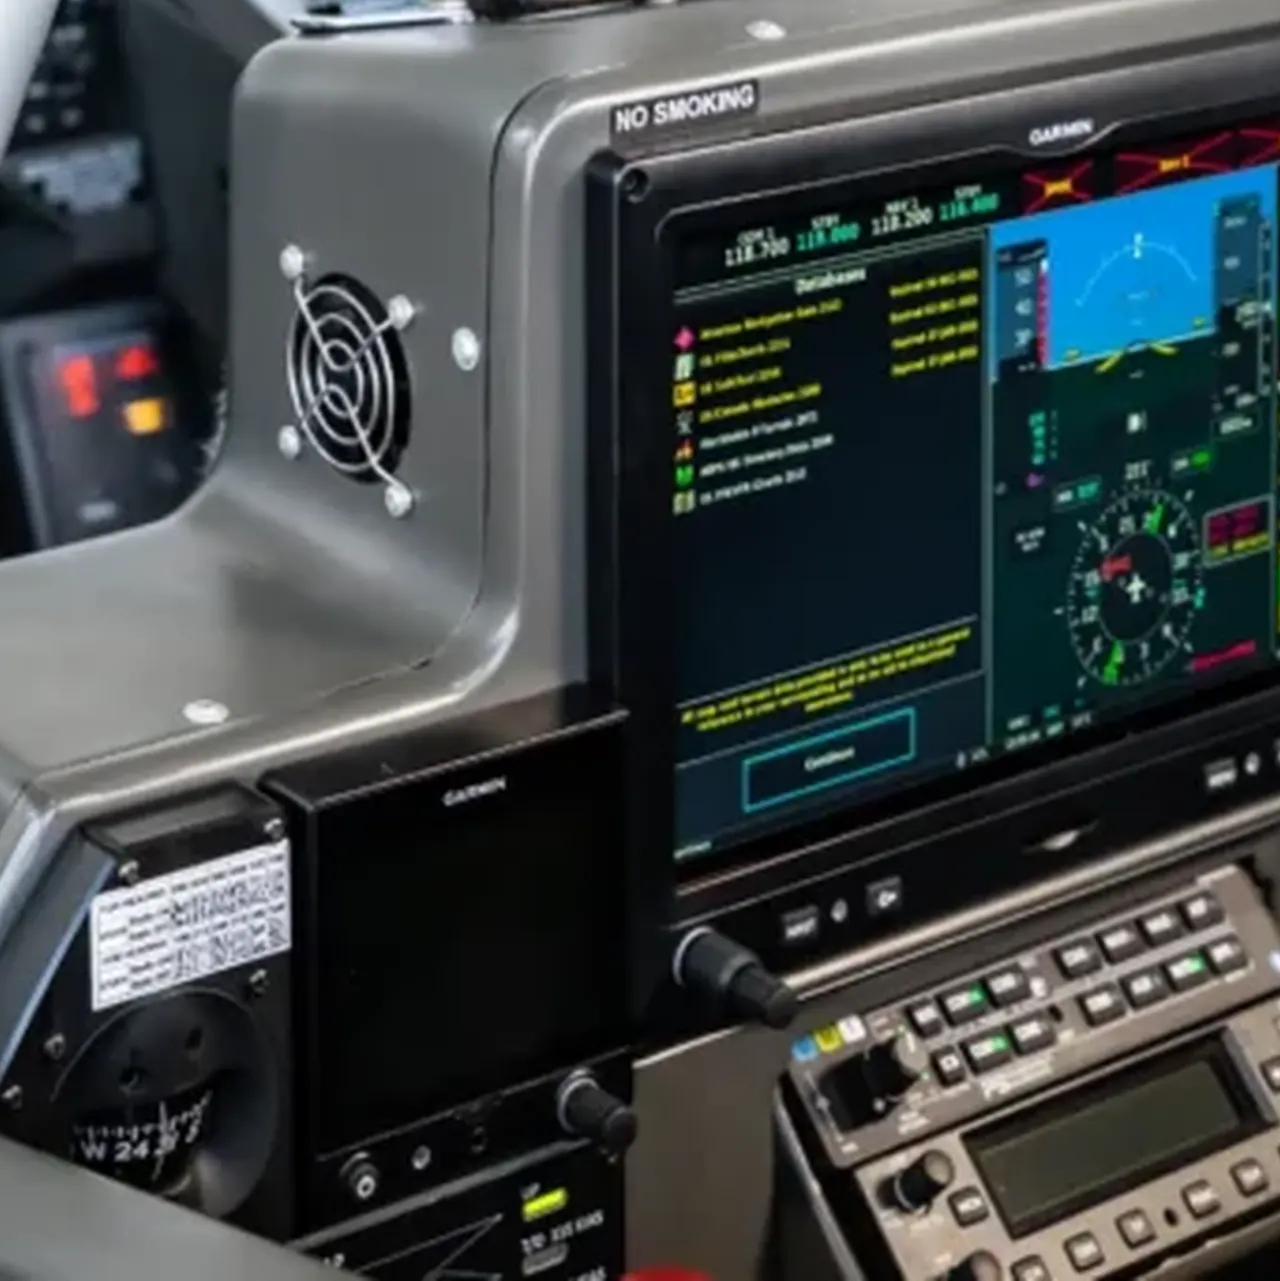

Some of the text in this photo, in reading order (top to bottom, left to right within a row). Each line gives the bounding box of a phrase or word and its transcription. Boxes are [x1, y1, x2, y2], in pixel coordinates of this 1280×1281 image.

[616, 84, 754, 132] NO SMOKING
[1029, 119, 1093, 146] GARMIN
[795, 268, 867, 296] Databases
[442, 775, 507, 807] GARMIN
[80, 1139, 107, 1161] W
[114, 1140, 149, 1162] 24
